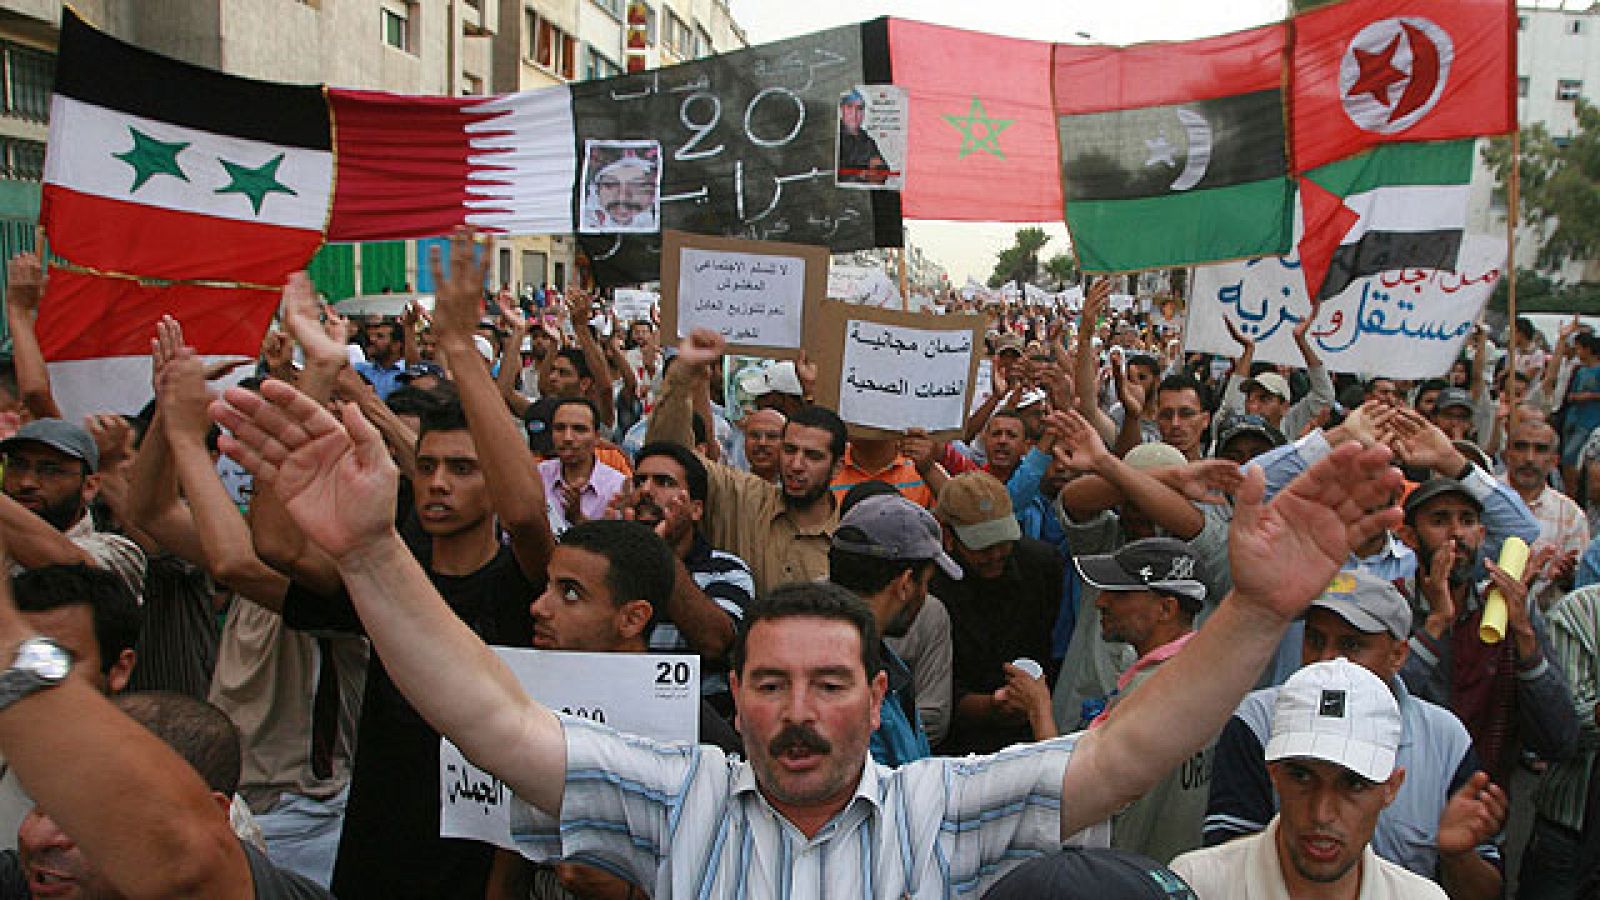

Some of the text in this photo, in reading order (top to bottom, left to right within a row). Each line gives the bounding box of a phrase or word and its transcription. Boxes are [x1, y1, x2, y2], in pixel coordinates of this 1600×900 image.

[674, 87, 807, 161] 20
[1316, 280, 1471, 352] مستقل
[850, 321, 969, 358] ضمان مجانية
[846, 366, 908, 396] الصحية
[655, 661, 692, 686] 20
